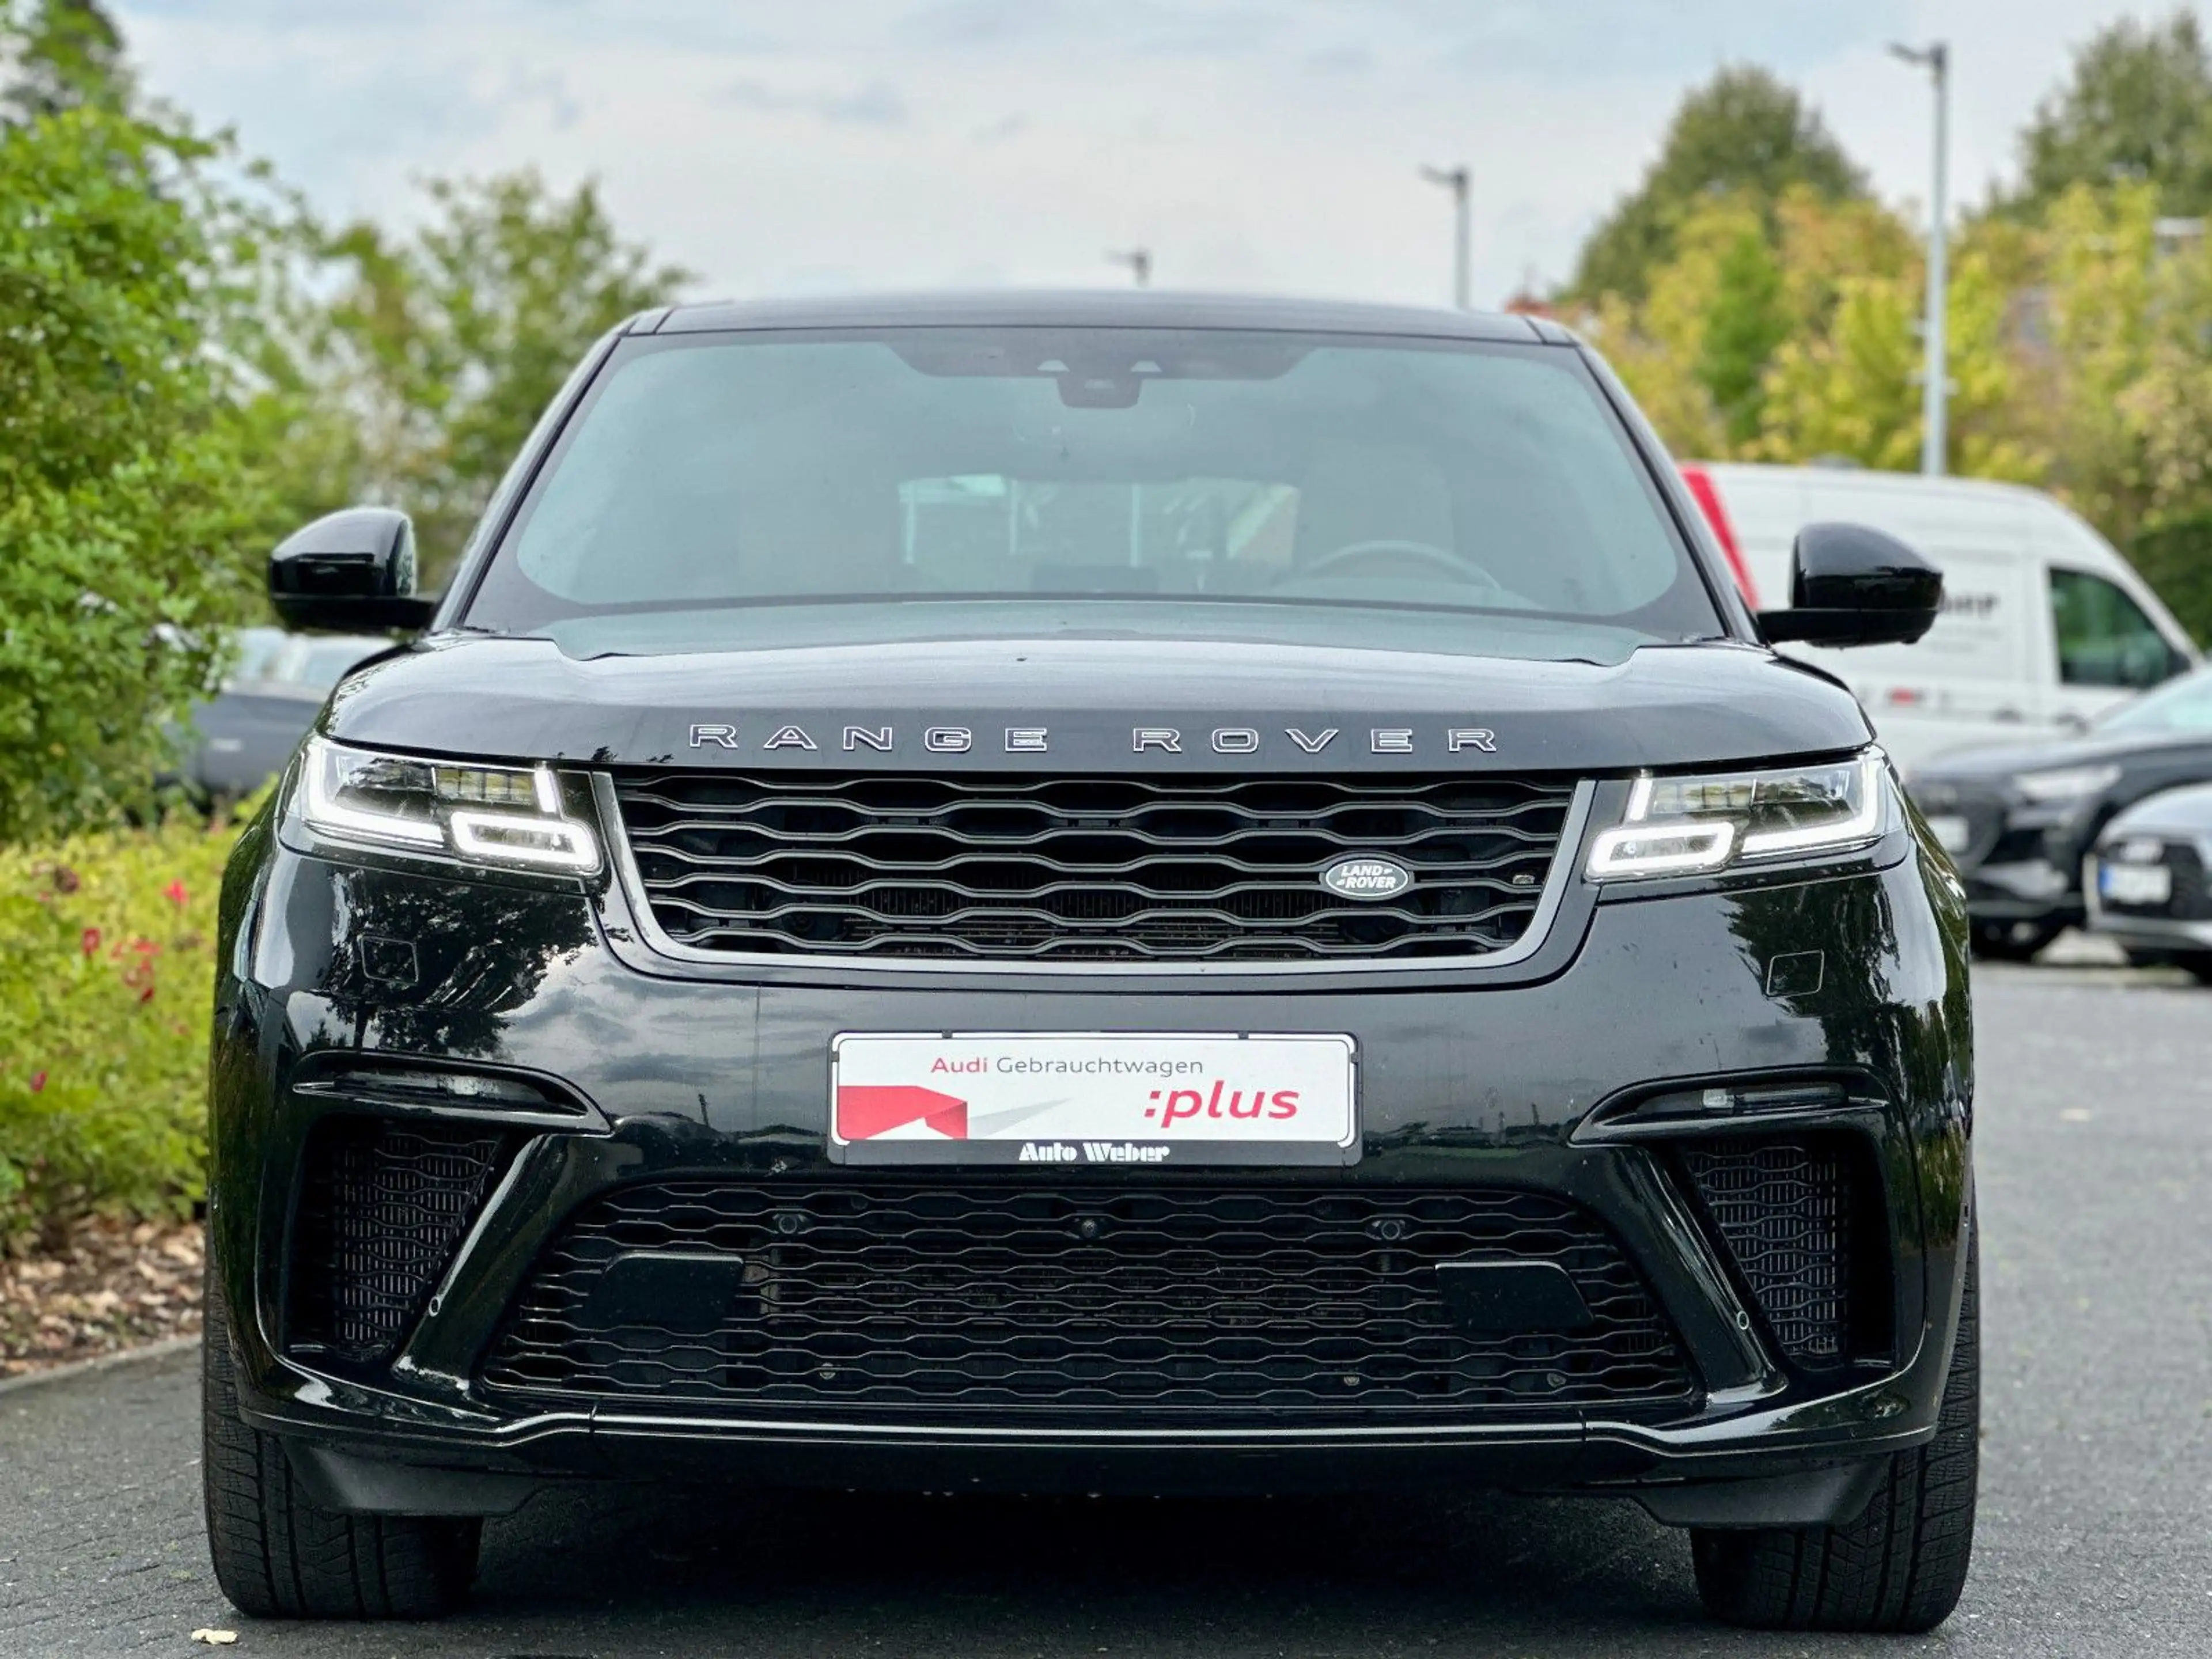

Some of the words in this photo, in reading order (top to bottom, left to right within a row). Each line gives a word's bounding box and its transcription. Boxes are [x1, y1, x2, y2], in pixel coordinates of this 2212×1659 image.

[690, 724, 1047, 752] RANGE
[1132, 728, 1497, 753] ROVER
[1341, 865, 1382, 877] LAND
[1344, 877, 1396, 889] ROVER
[930, 1056, 988, 1074] Audi
[997, 1057, 1204, 1078] Gebrauchtwagen
[1144, 1080, 1300, 1128] :plus
[1018, 1142, 1078, 1162] Auto
[1082, 1142, 1171, 1163] Weber
